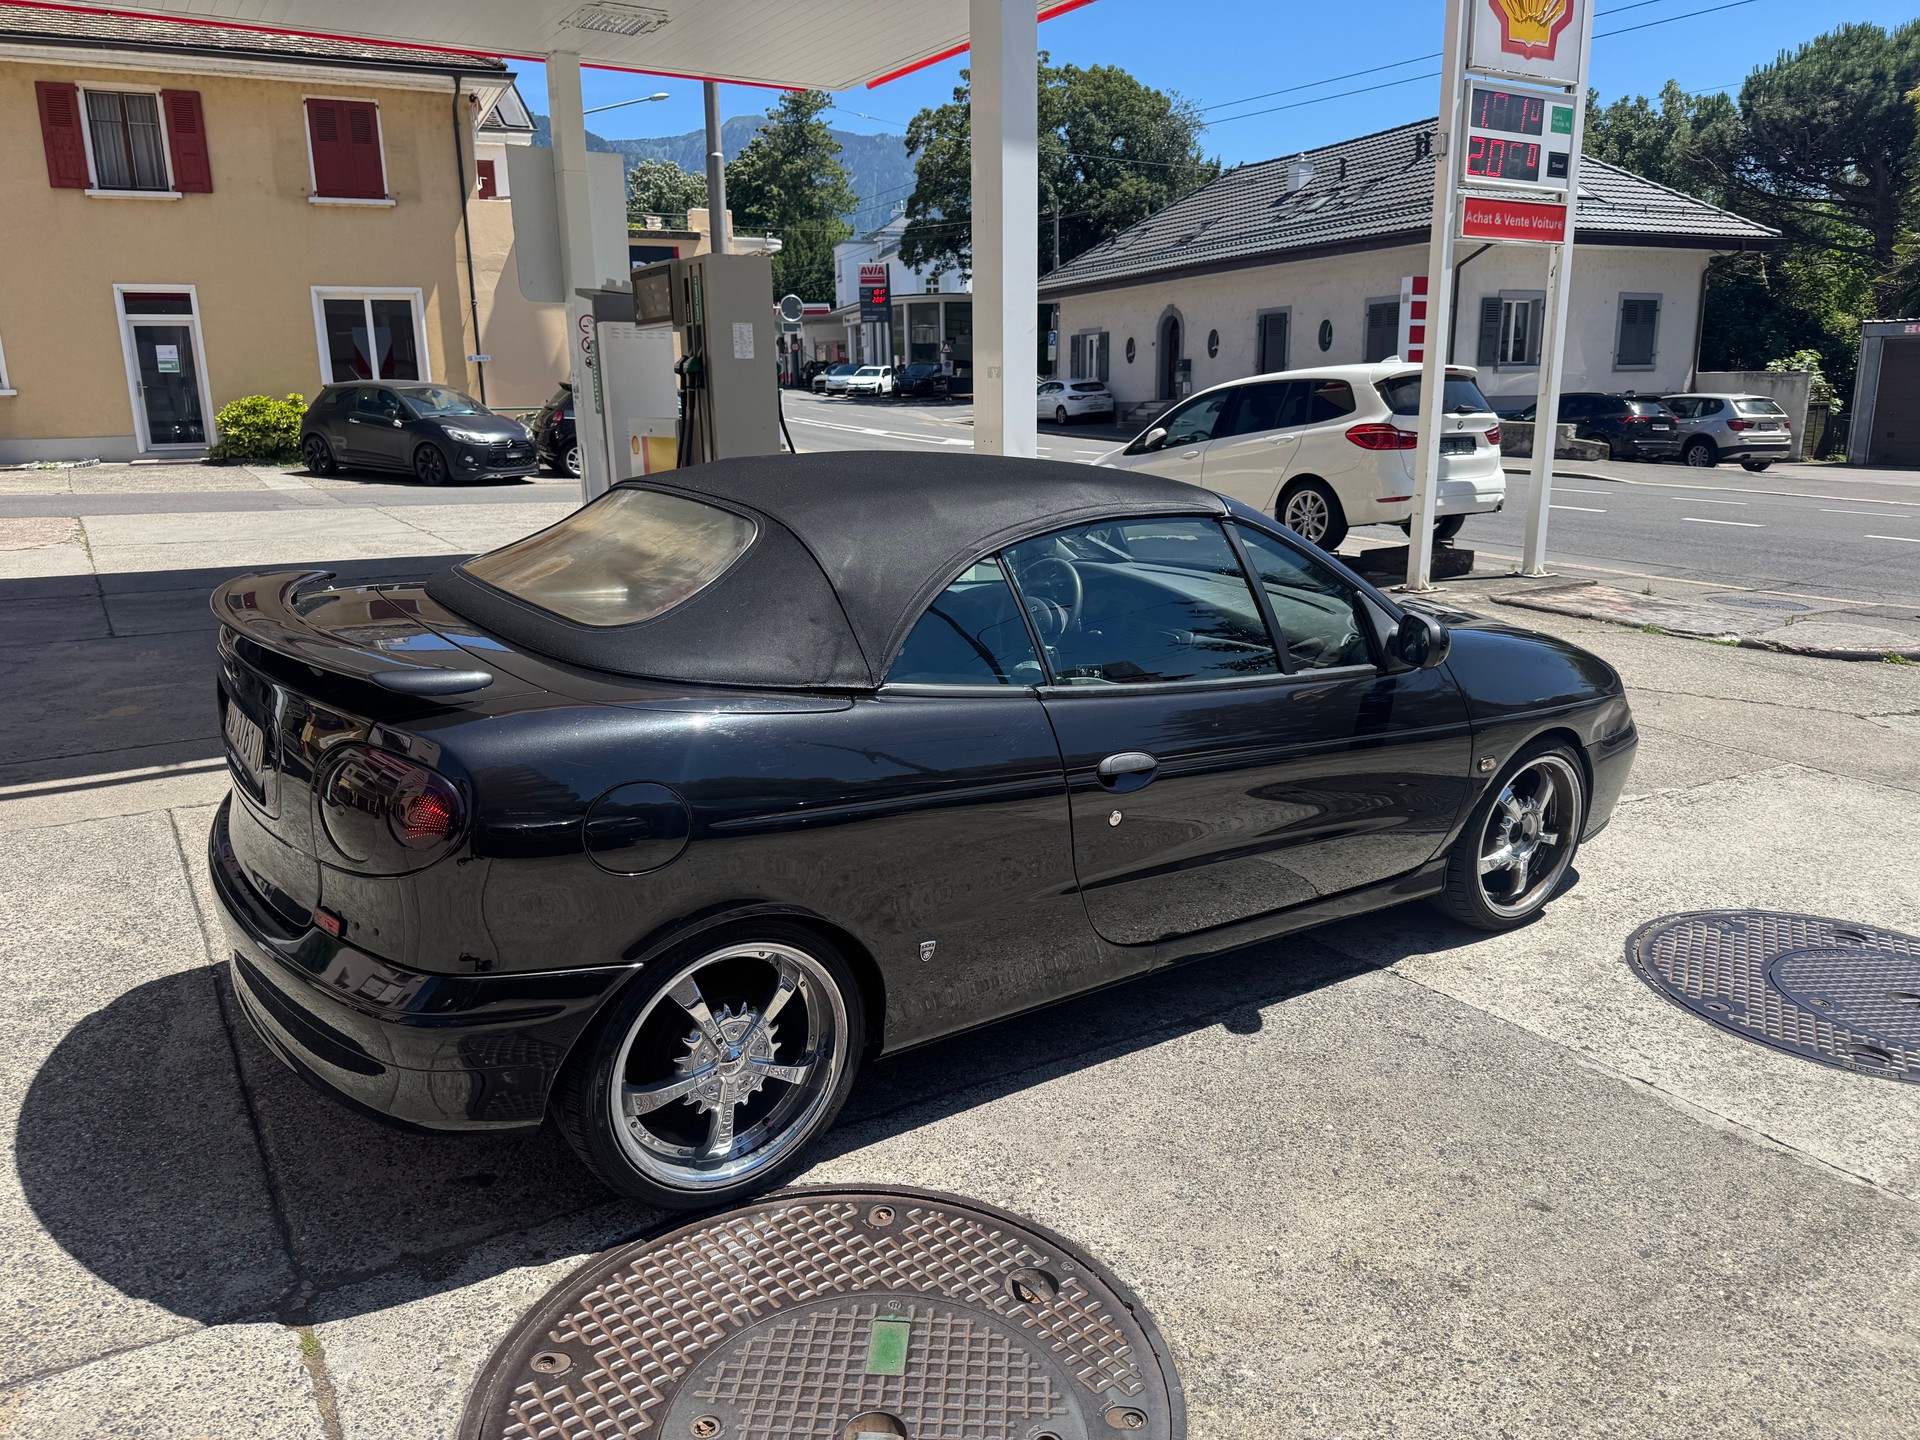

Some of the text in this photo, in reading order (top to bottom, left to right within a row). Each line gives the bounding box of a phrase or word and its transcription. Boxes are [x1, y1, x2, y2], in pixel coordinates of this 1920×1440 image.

[1465, 211, 1563, 230] Achat & Vente Voiture
[860, 264, 885, 276] AVIA
